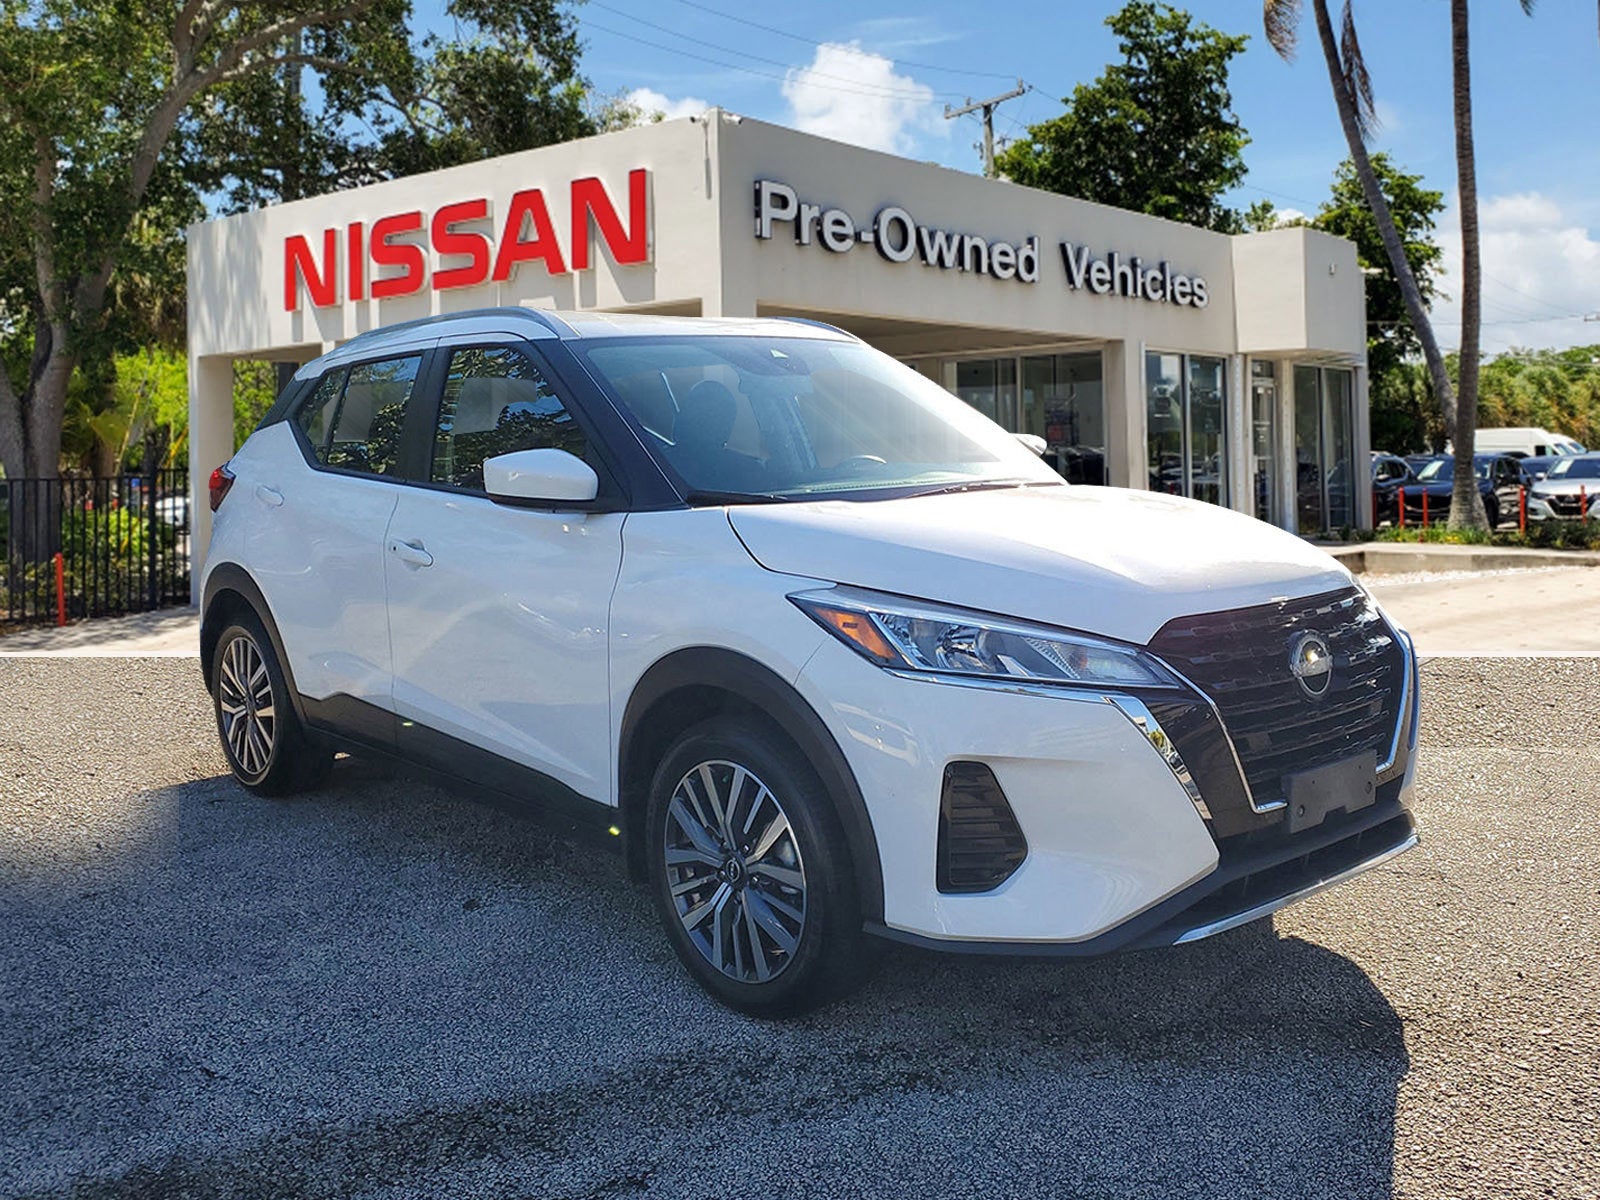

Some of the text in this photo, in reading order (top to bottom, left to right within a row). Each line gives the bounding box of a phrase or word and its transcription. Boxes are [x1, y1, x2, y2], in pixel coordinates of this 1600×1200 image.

[285, 168, 648, 311] NISSAN
[755, 180, 1208, 308] Pre-Owned Vehicles
